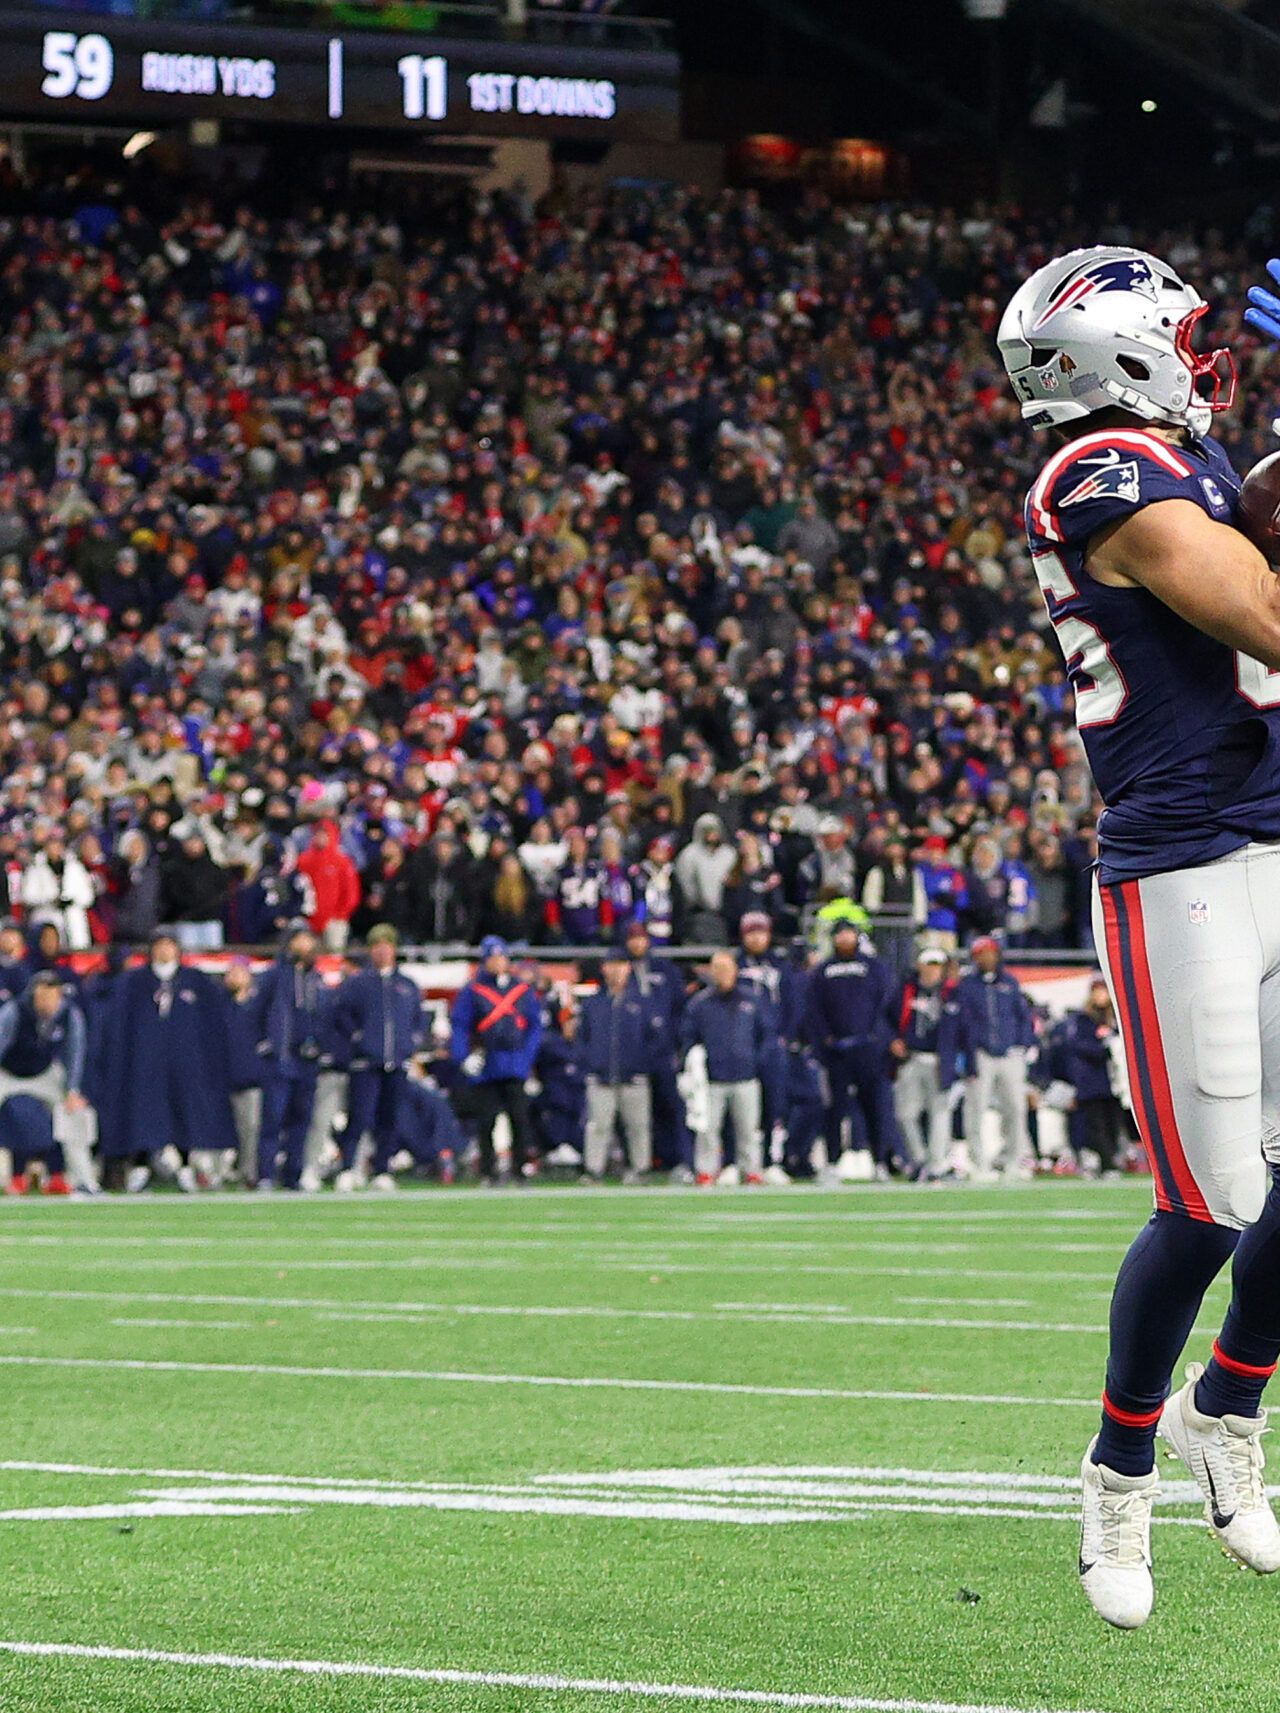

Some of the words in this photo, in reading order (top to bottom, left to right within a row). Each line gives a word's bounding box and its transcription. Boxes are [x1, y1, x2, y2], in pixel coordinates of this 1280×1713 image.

[41, 31, 115, 100] 59
[142, 52, 217, 95] RUSH
[217, 57, 276, 99] YDS
[397, 54, 448, 120] 11
[466, 72, 516, 113] 1ST
[516, 75, 616, 120] DOWNS
